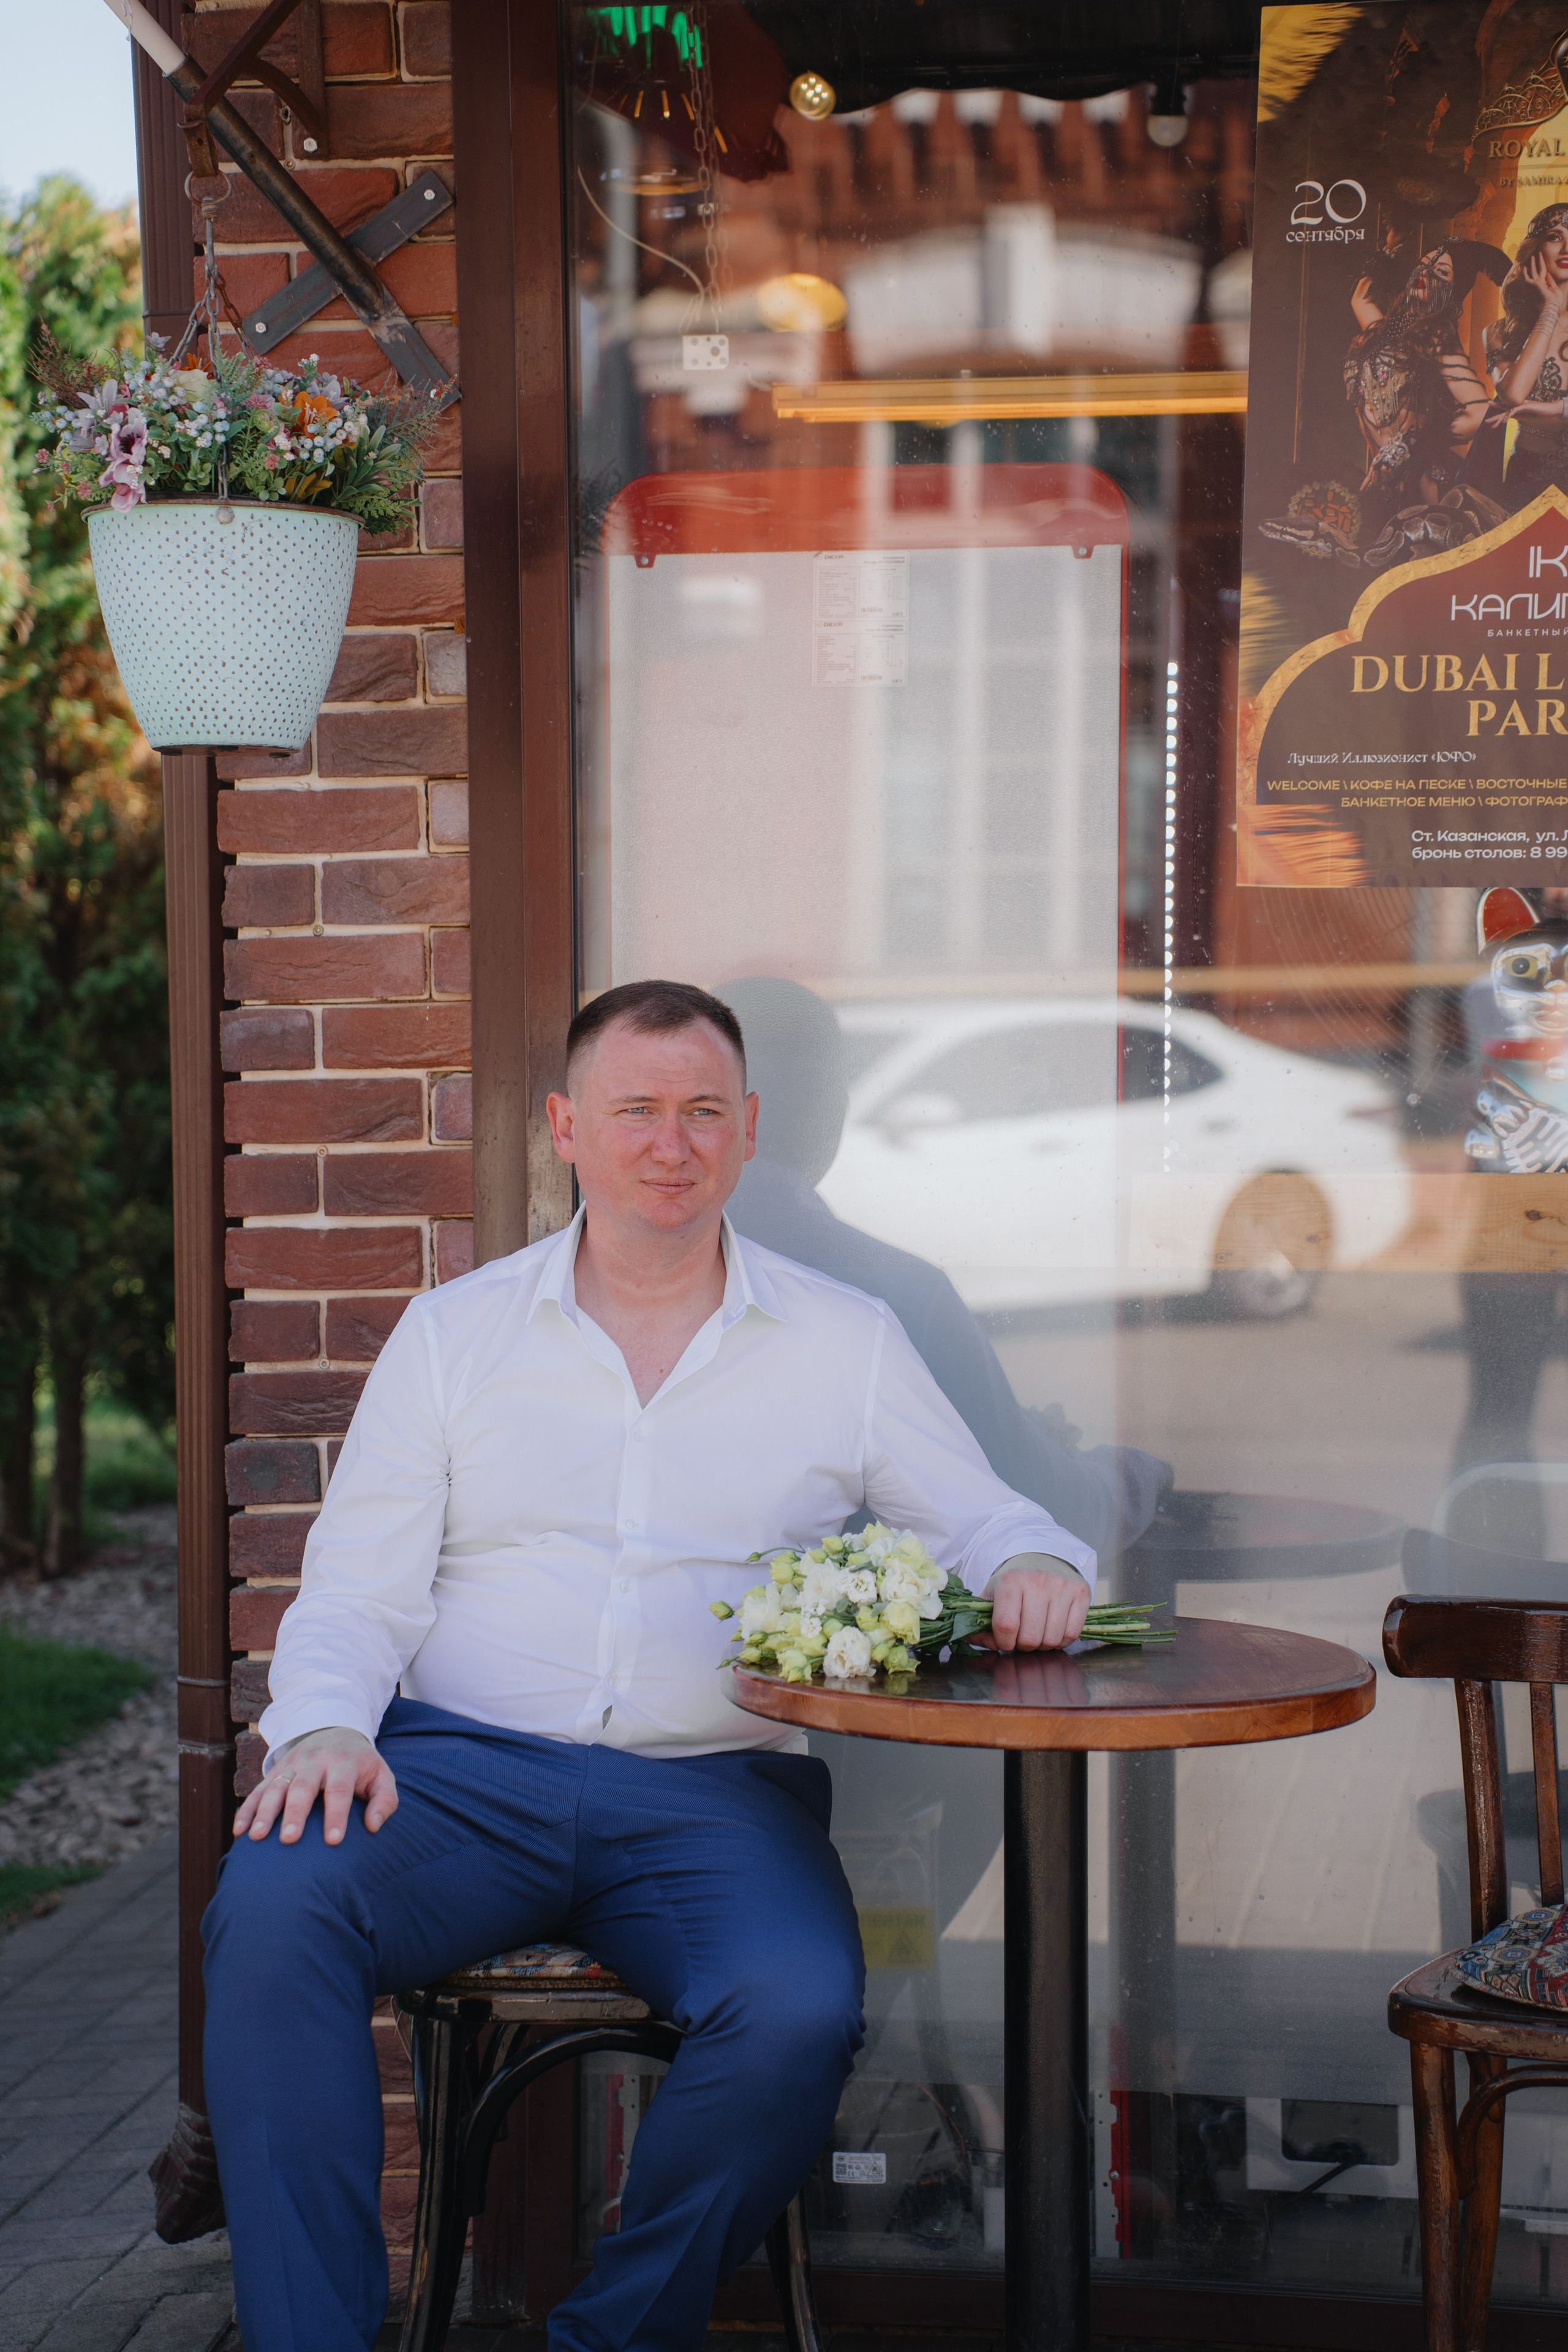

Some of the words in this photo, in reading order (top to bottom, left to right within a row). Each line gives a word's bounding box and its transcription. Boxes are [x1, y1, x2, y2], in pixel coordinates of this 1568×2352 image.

[1488, 138, 1566, 159] ROYAL
[1499, 176, 1513, 187] BY
[1291, 179, 1366, 225] 20
[1286, 226, 1365, 244] сентября
[1451, 593, 1568, 620] КАЛИ
[1351, 652, 1520, 693] DUBAI
[1287, 752, 1339, 766] Лучший
[1342, 752, 1428, 764] Иллюзионист
[1431, 751, 1477, 763] «ЮФО»
[1267, 780, 1340, 791] WELCOME
[1351, 780, 1392, 790] КОФЕ
[1395, 779, 1416, 790] НА
[1419, 778, 1466, 790] ПЕСКЕ
[1476, 778, 1567, 789] ВОСТОЧНЫЕ
[1341, 797, 1426, 807] БАНКЕТНОЕ
[1429, 796, 1476, 807] МЕНЮ
[1411, 830, 1434, 842] Ст.
[1438, 830, 1530, 843] Казанская,
[1536, 831, 1559, 843] ул.
[1412, 846, 1462, 861] бронь
[1464, 848, 1526, 859] столов:
[1530, 846, 1542, 859] 8
